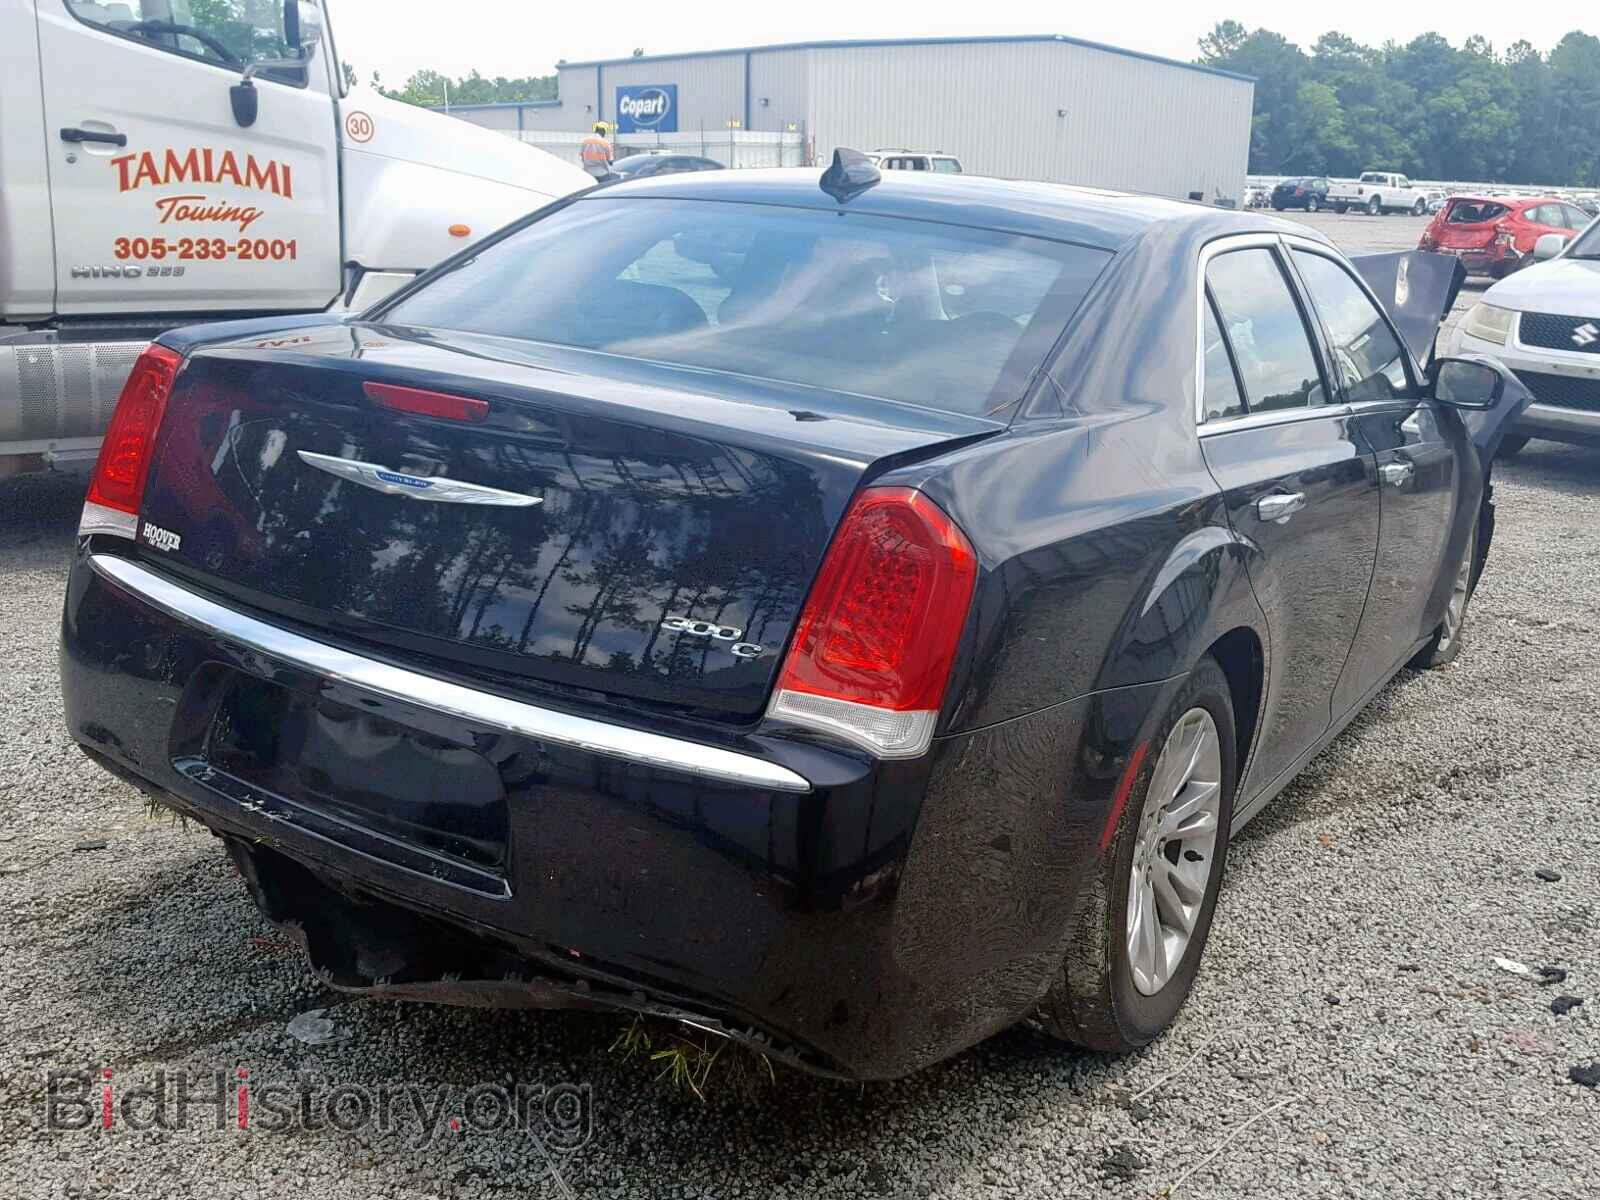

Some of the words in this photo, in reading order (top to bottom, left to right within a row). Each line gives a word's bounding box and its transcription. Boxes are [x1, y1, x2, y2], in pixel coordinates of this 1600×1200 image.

[620, 95, 664, 118] Copart
[350, 118, 370, 135] 30
[111, 148, 293, 200] TAMIAMI
[156, 196, 264, 232] Towing
[114, 237, 297, 260] 305-233-2001
[71, 264, 142, 278] HINO
[142, 522, 181, 550] HOOVER
[661, 616, 742, 640] 300
[730, 642, 763, 658] C
